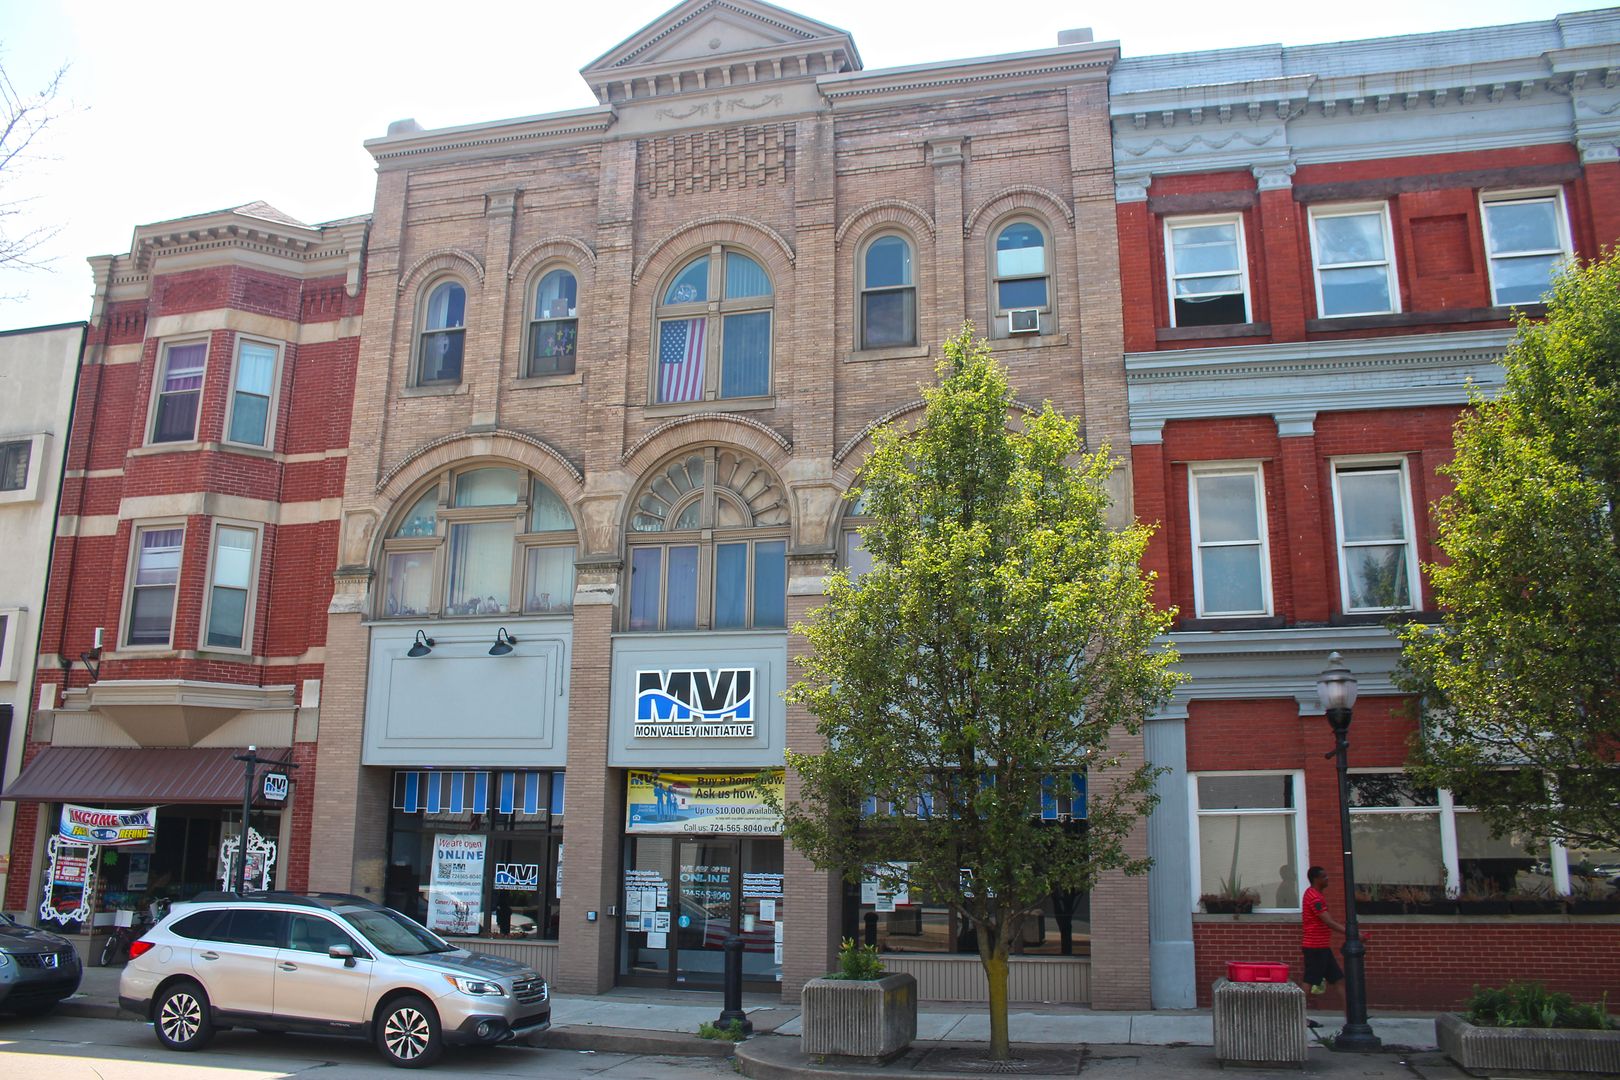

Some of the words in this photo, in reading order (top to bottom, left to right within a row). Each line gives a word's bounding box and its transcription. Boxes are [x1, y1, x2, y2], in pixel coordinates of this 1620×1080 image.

[637, 669, 752, 721] MVI
[635, 725, 657, 737] MON
[661, 725, 697, 736] VALLEY
[700, 725, 753, 736] INITIATIVE
[266, 776, 286, 793] MVI
[697, 777, 717, 787] Buy
[695, 788, 715, 799] Ask
[718, 790, 730, 799] us
[733, 788, 758, 799] how.
[695, 807, 705, 816] Up
[706, 807, 714, 815] to
[715, 806, 746, 816] $10,000
[747, 806, 780, 815] availab
[70, 809, 119, 828] INCOME
[119, 812, 150, 827] TAX
[118, 828, 149, 839] REFUND
[684, 824, 697, 832] Call
[710, 824, 763, 833] 724-565-8040
[439, 838, 451, 847] We
[451, 839, 463, 848] are
[464, 841, 482, 850] open
[438, 850, 484, 860] ONLINE
[496, 864, 538, 885] MVI
[680, 865, 694, 873] WE
[711, 866, 731, 874] OPEN
[680, 873, 730, 883] ONLINE
